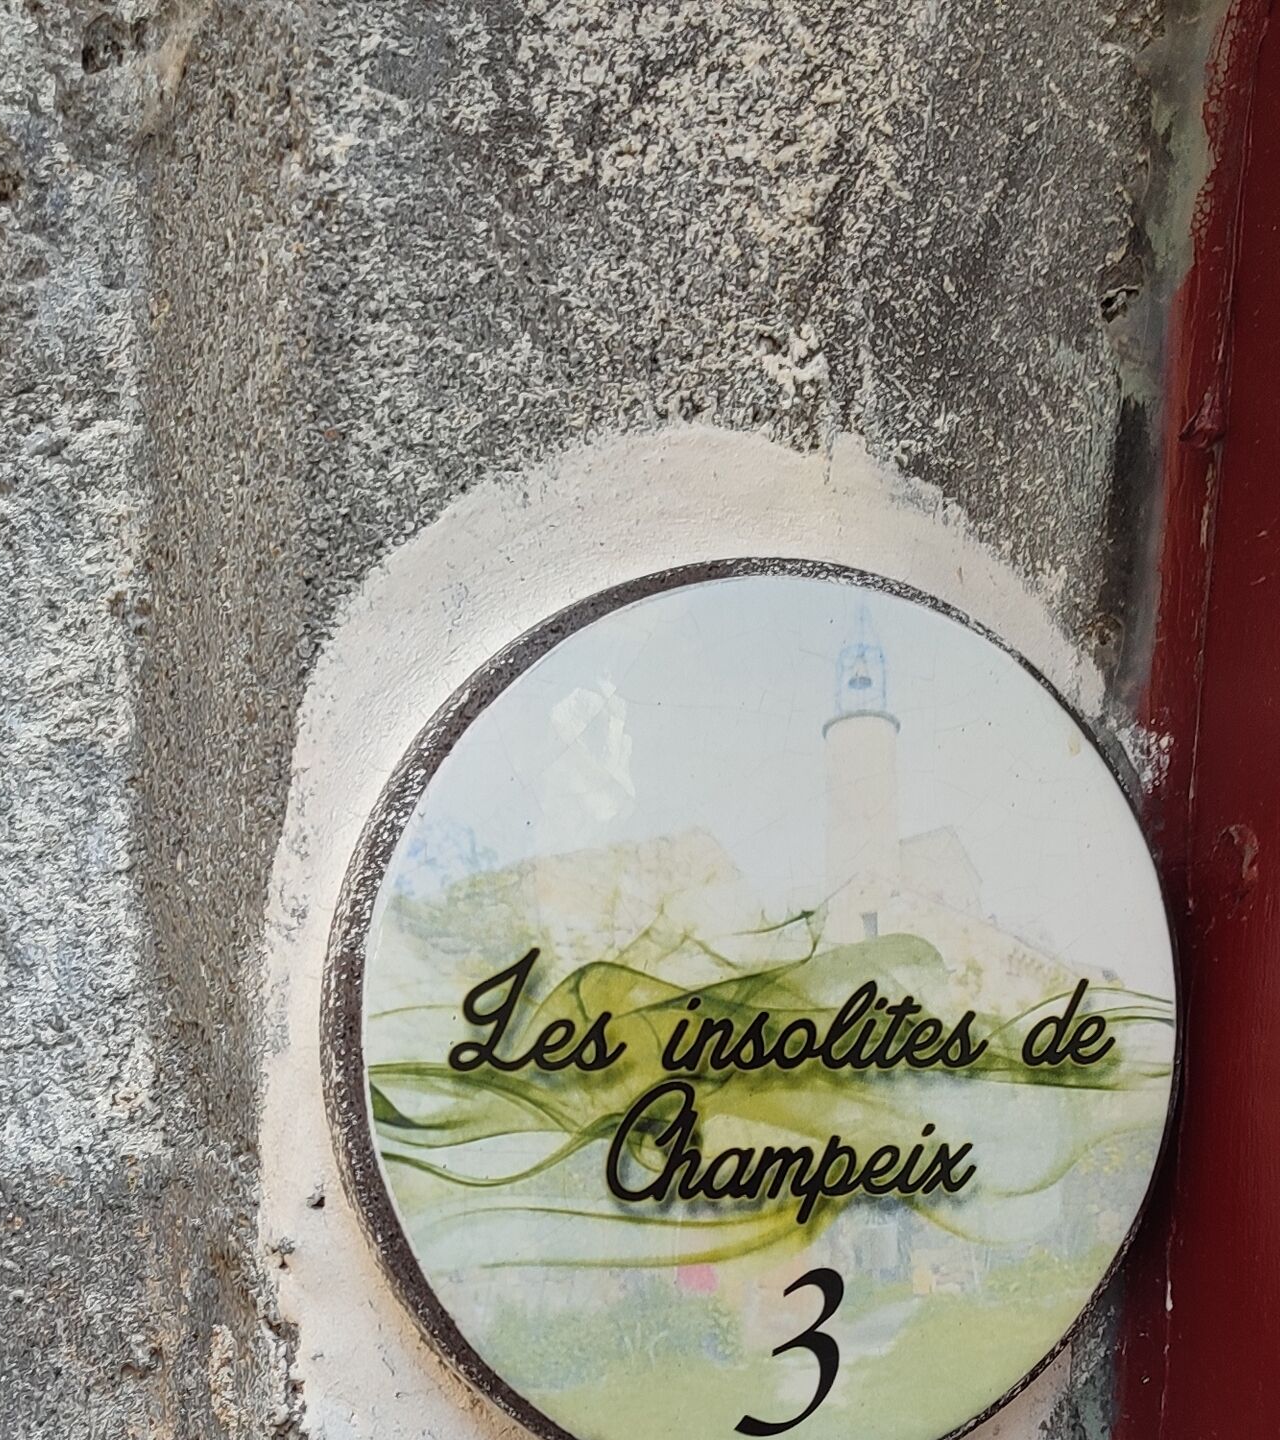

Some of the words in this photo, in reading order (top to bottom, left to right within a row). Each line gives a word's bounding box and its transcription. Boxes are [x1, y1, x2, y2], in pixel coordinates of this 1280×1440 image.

[448, 946, 626, 1073] Les
[661, 979, 988, 1072] insolites
[1022, 978, 1116, 1067] de
[606, 1080, 978, 1225] Champeix
[733, 1266, 846, 1438] 3
